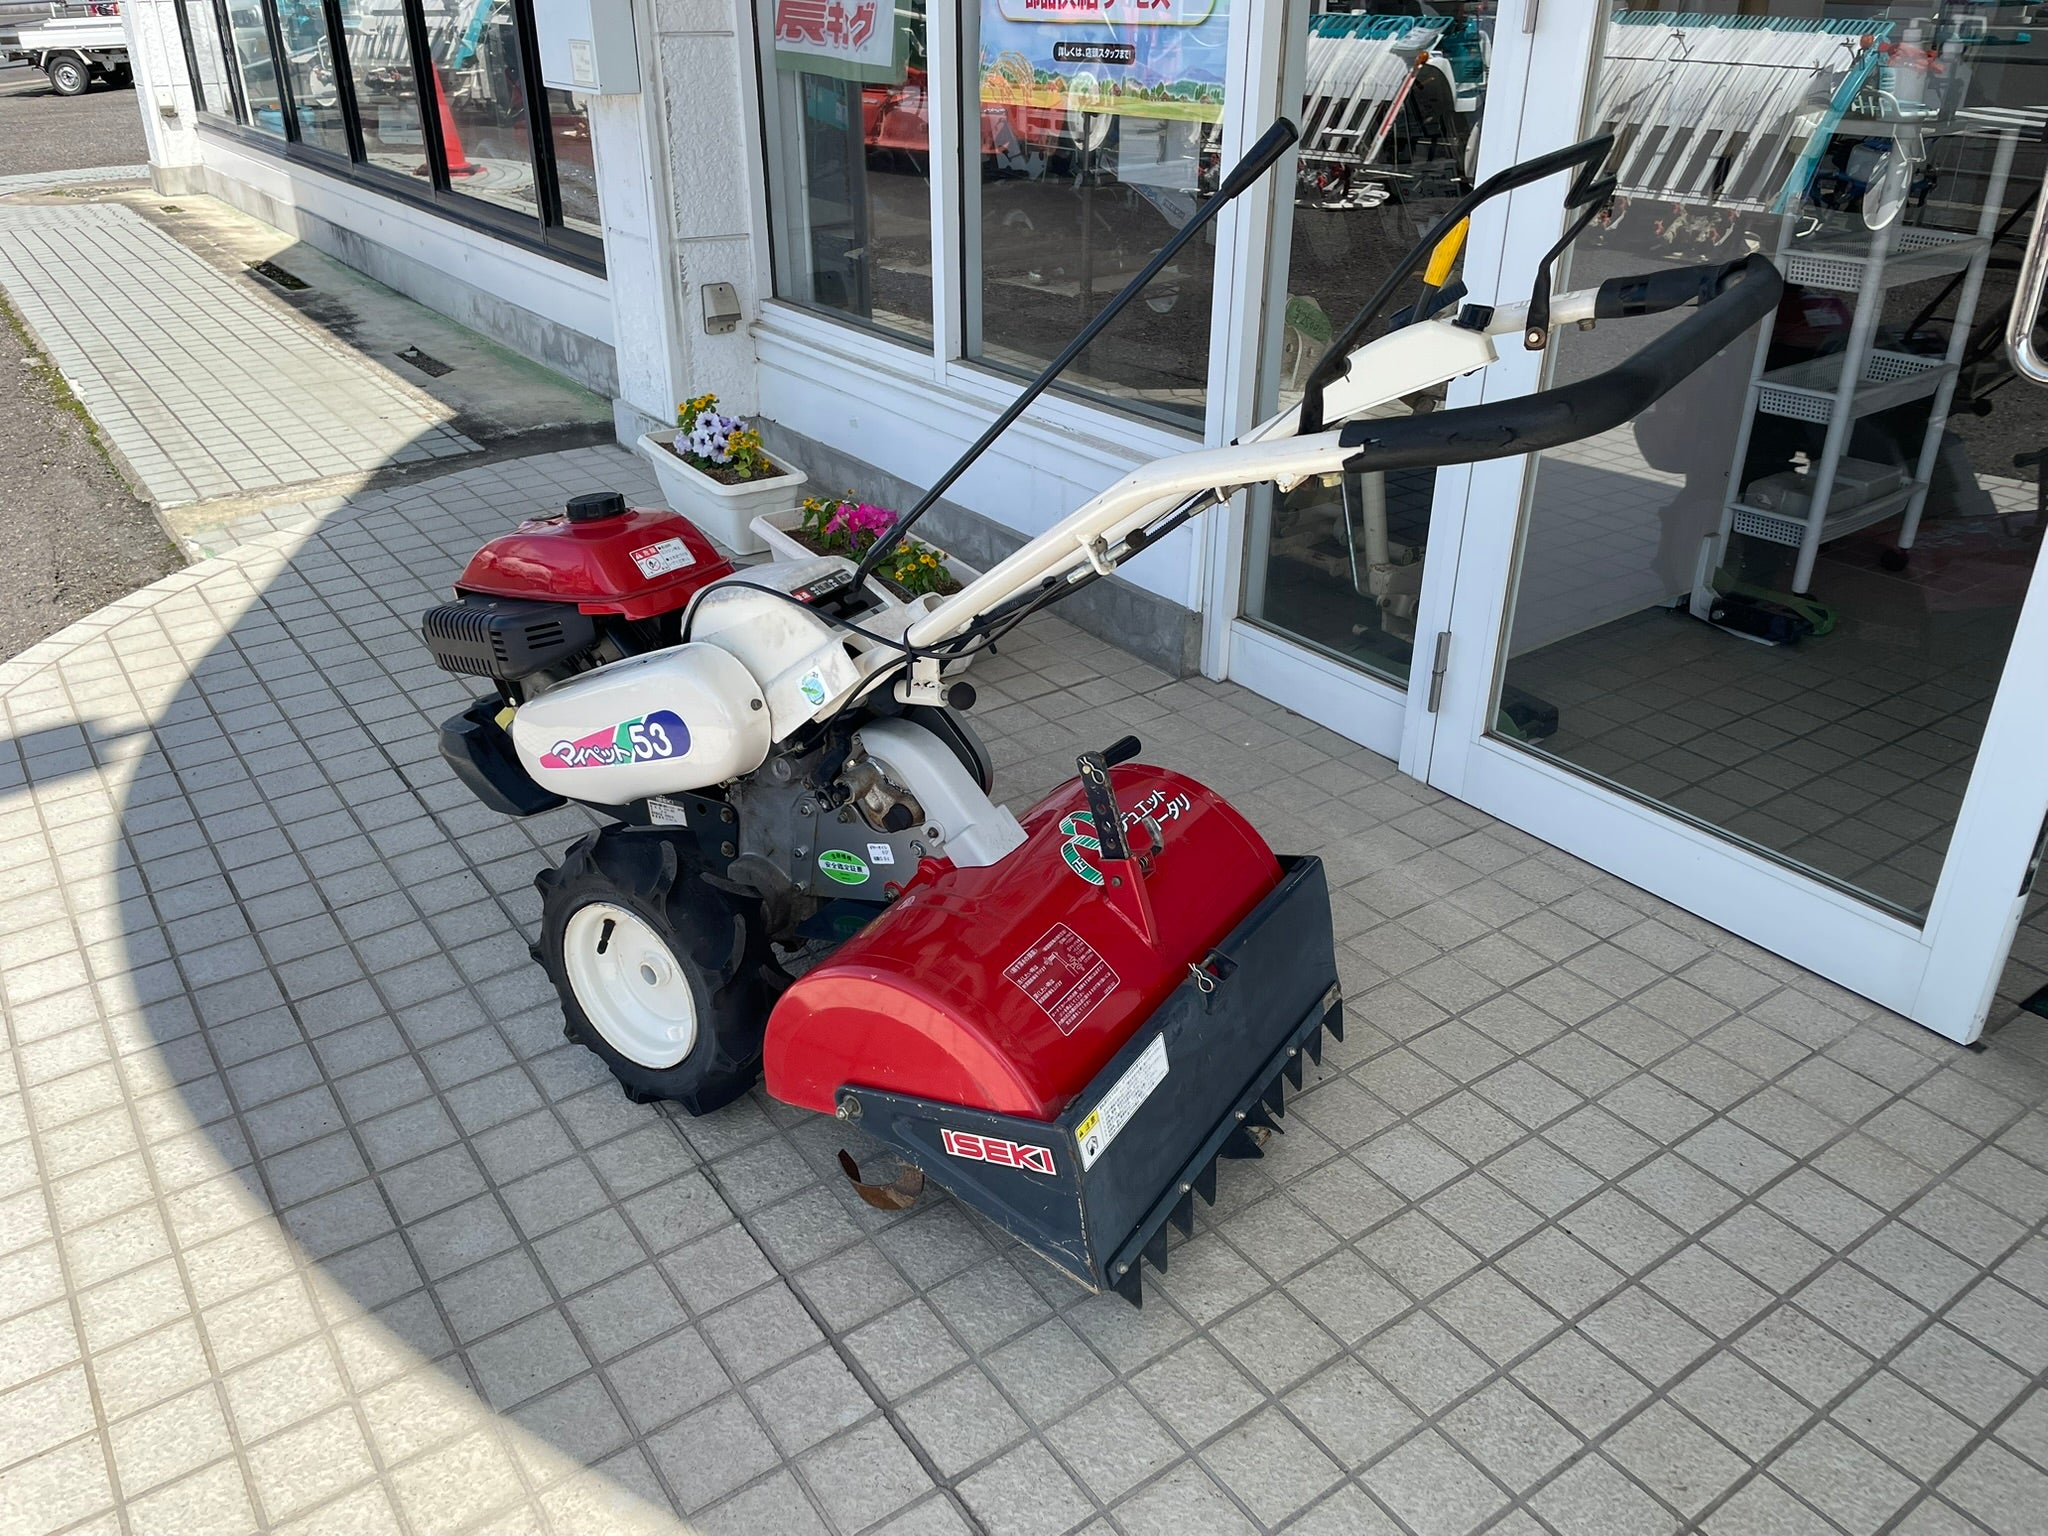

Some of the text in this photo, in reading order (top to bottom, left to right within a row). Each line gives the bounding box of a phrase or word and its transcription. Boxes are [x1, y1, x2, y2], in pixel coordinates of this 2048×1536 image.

[628, 722, 673, 759] 53
[1153, 793, 1191, 831] ータリ
[942, 1130, 1056, 1174] ISEKI
